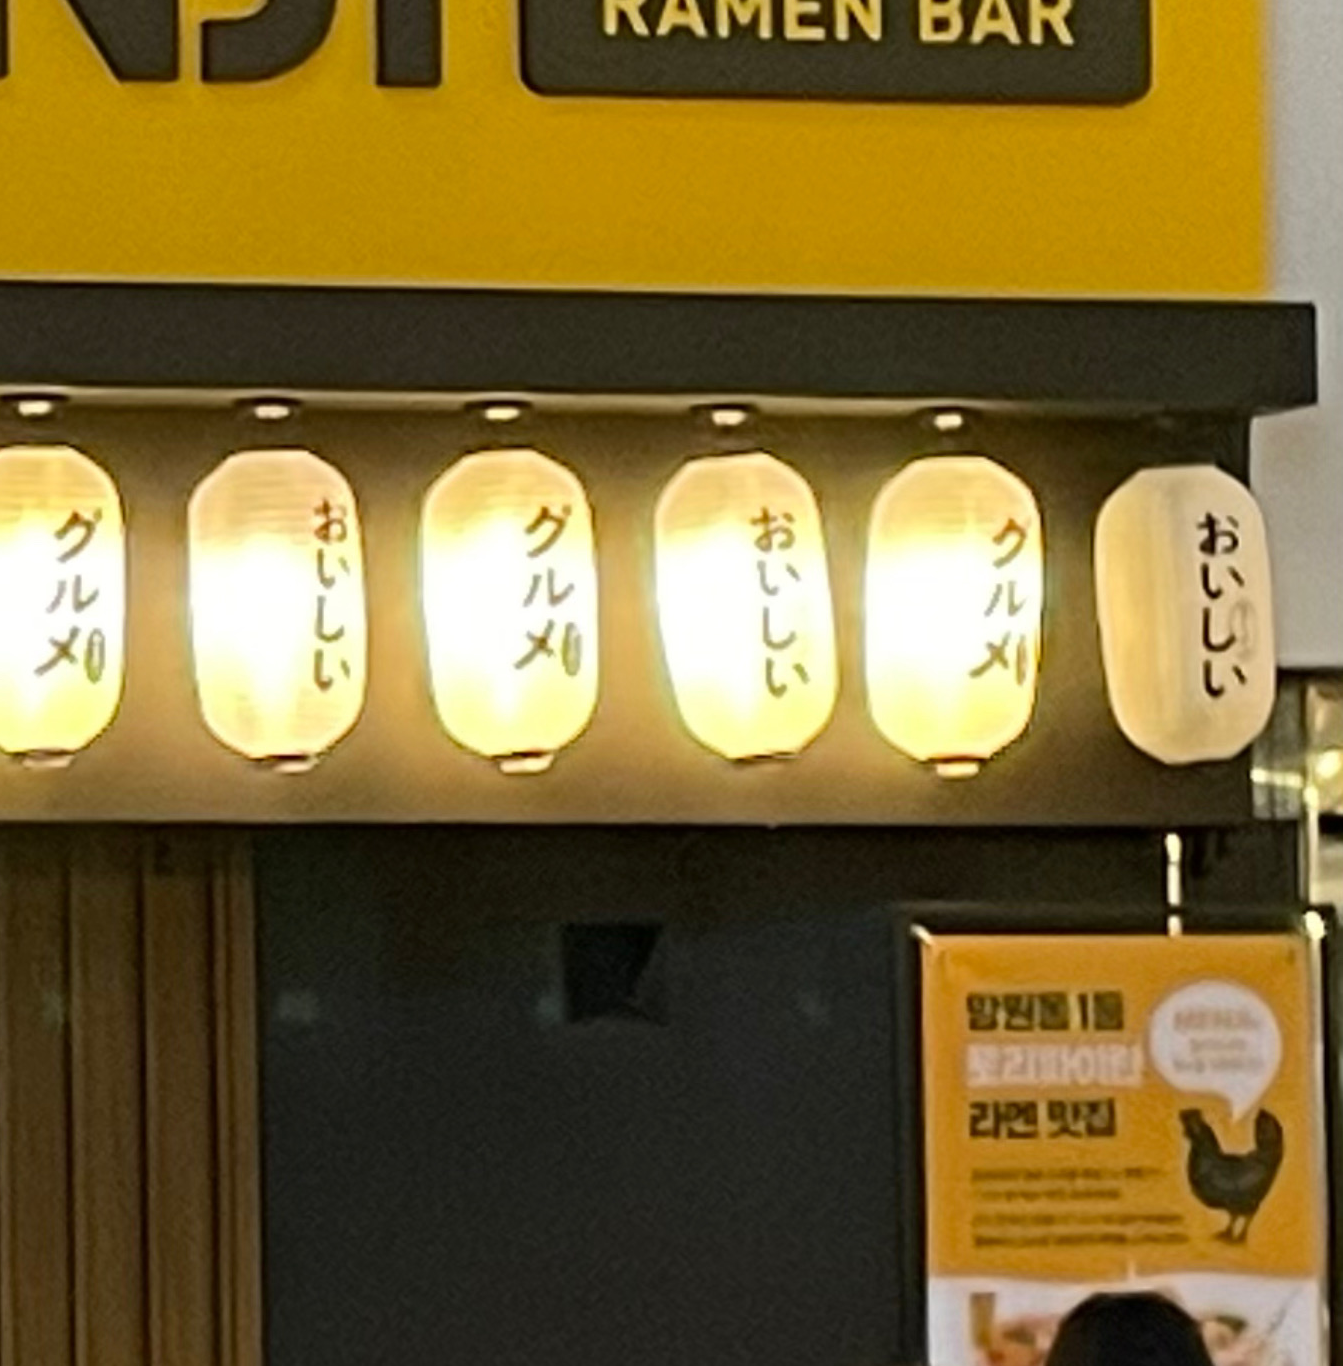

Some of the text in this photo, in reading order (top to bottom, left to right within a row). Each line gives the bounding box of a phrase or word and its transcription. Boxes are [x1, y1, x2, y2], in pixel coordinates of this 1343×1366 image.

[34, 508, 102, 677] グルメ
[314, 498, 350, 692] おいしい
[514, 503, 574, 671] グルメ
[749, 506, 809, 698] おいしい
[1196, 511, 1246, 698] おいしい
